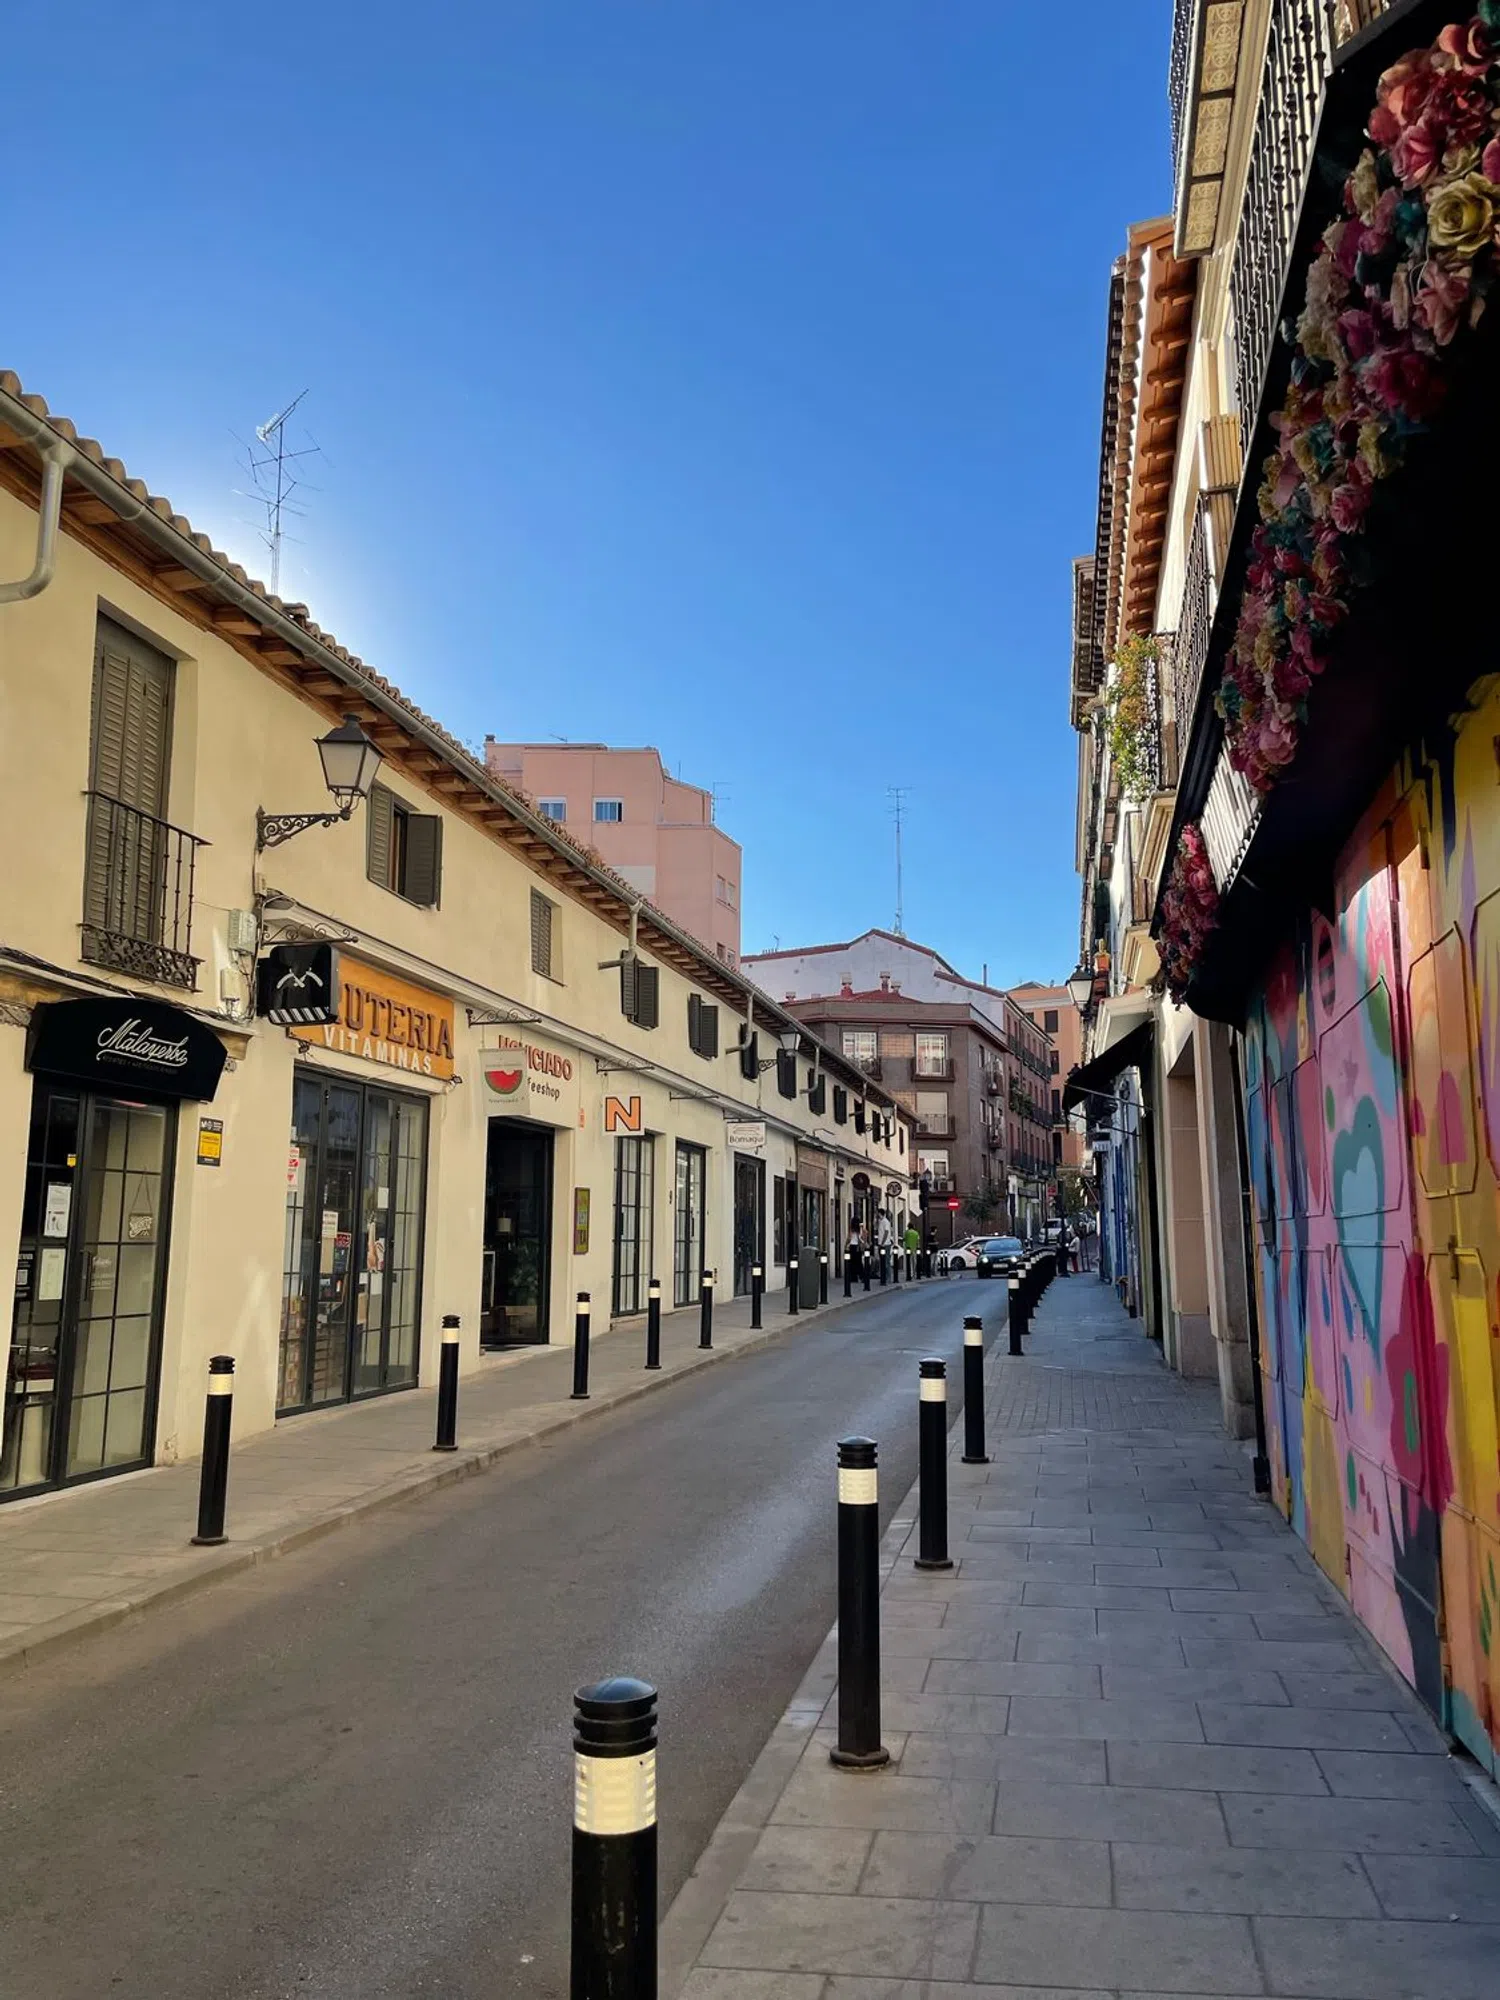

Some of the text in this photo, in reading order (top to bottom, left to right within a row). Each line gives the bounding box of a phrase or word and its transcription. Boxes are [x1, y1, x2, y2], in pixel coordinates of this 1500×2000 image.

[336, 983, 454, 1059] UTERIA
[323, 1025, 432, 1075] VITAMINAS
[527, 1077, 560, 1102] feeshop
[605, 1096, 641, 1132] N
